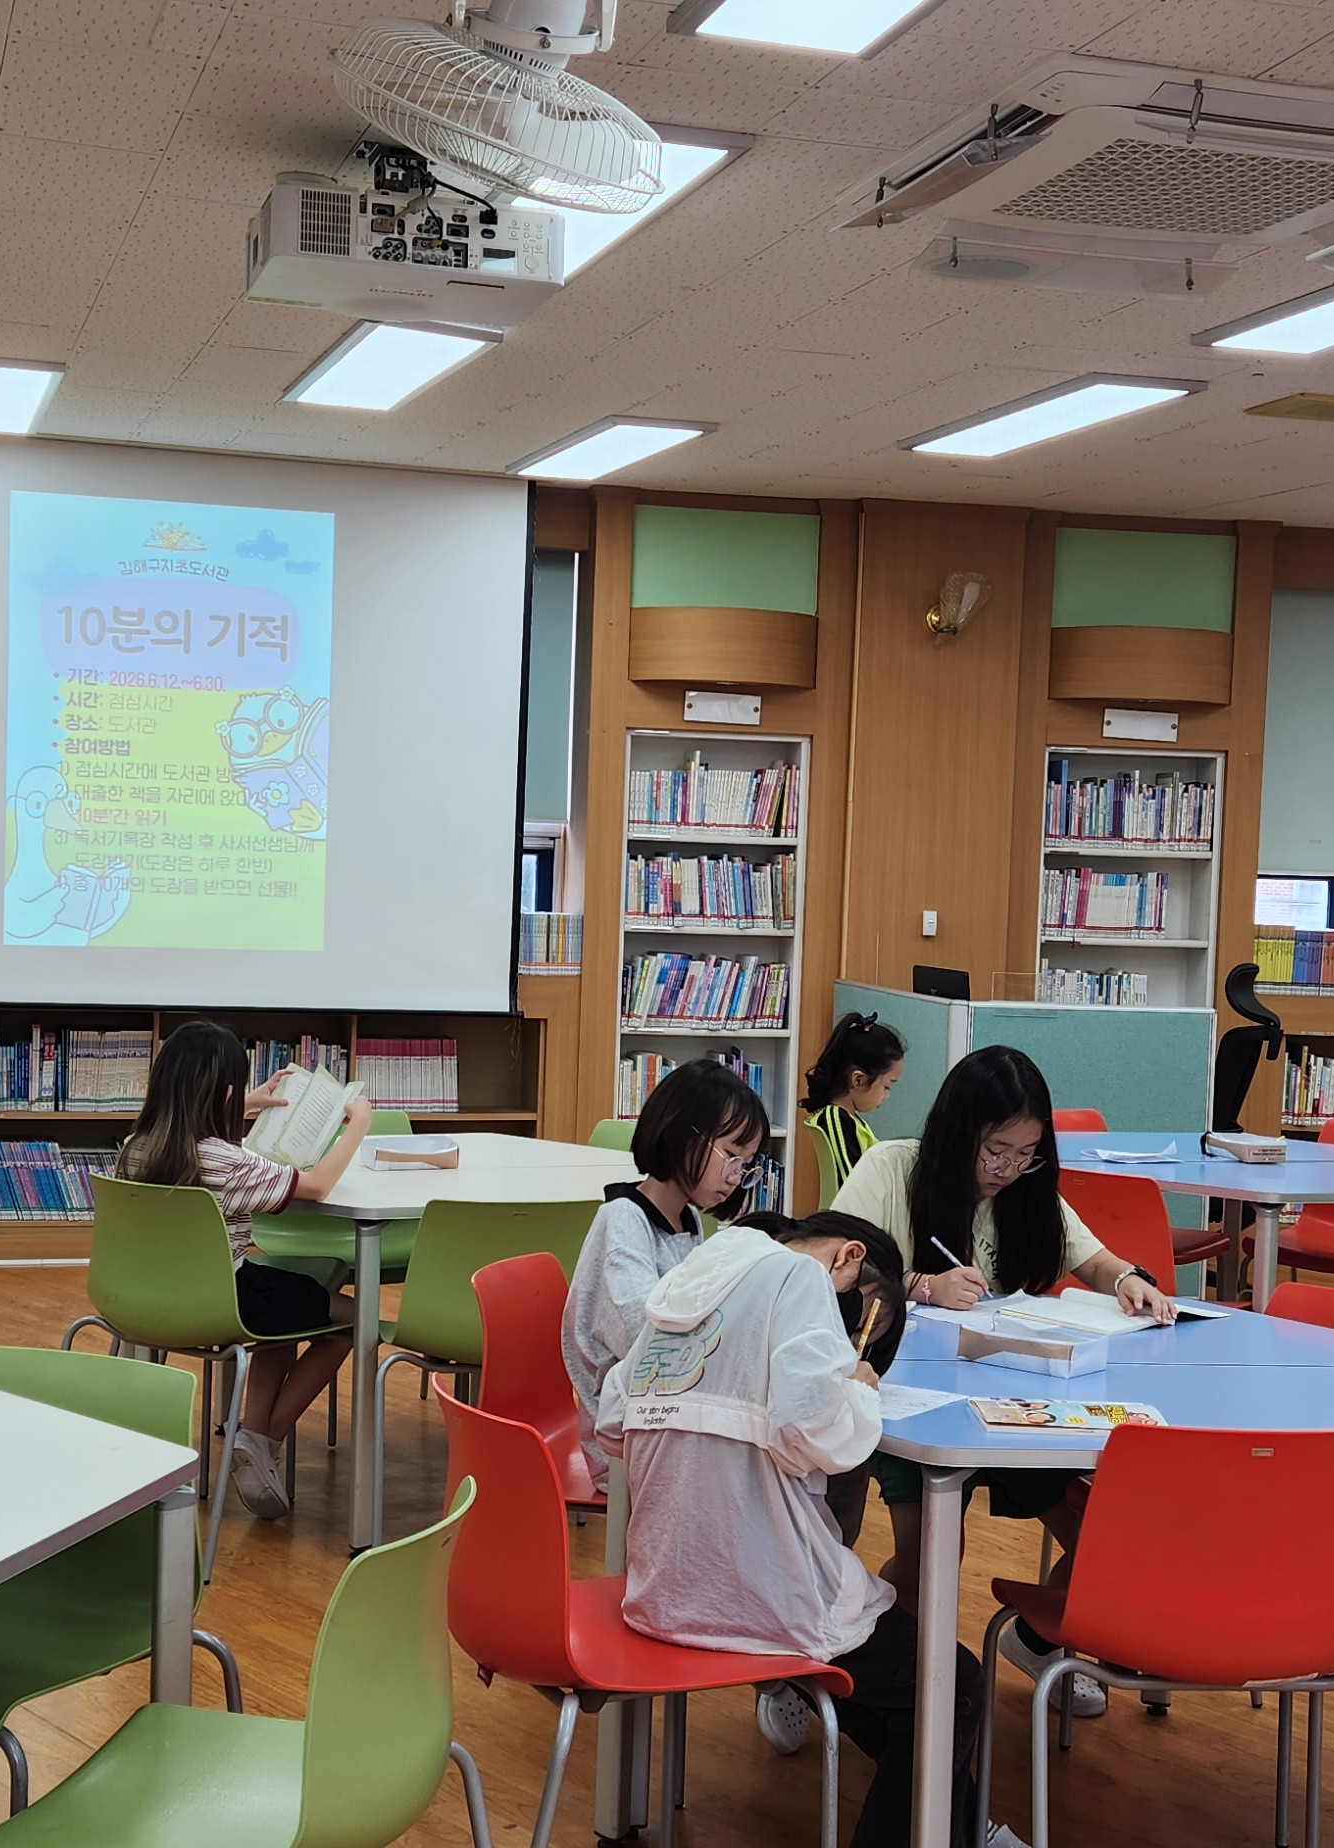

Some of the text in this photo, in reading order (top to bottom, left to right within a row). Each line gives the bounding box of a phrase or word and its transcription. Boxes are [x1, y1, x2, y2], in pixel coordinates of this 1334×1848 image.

[118, 558, 230, 582] 김해구지초도서관
[57, 605, 289, 662] 10분의 기적
[66, 668, 103, 686] 기간:
[66, 691, 175, 712] 시간: 점심시간
[65, 713, 156, 734] 장소: 도서관
[65, 737, 131, 757] 참여방법
[56, 760, 70, 776] 1)
[75, 761, 157, 780] 점심시간에
[162, 764, 211, 783] 도서관
[129, 786, 161, 804] 책을
[166, 789, 215, 806] 자리에
[135, 809, 167, 826] 읽기
[74, 829, 155, 849] 독서기록장
[161, 832, 193, 850] 작성
[198, 833, 214, 850] 후
[218, 835, 315, 854] 사서선생님께
[199, 856, 231, 873] 하루
[151, 878, 199, 895] 도장을
[204, 879, 252, 897] 받으면
[257, 881, 297, 898] 선물!!
